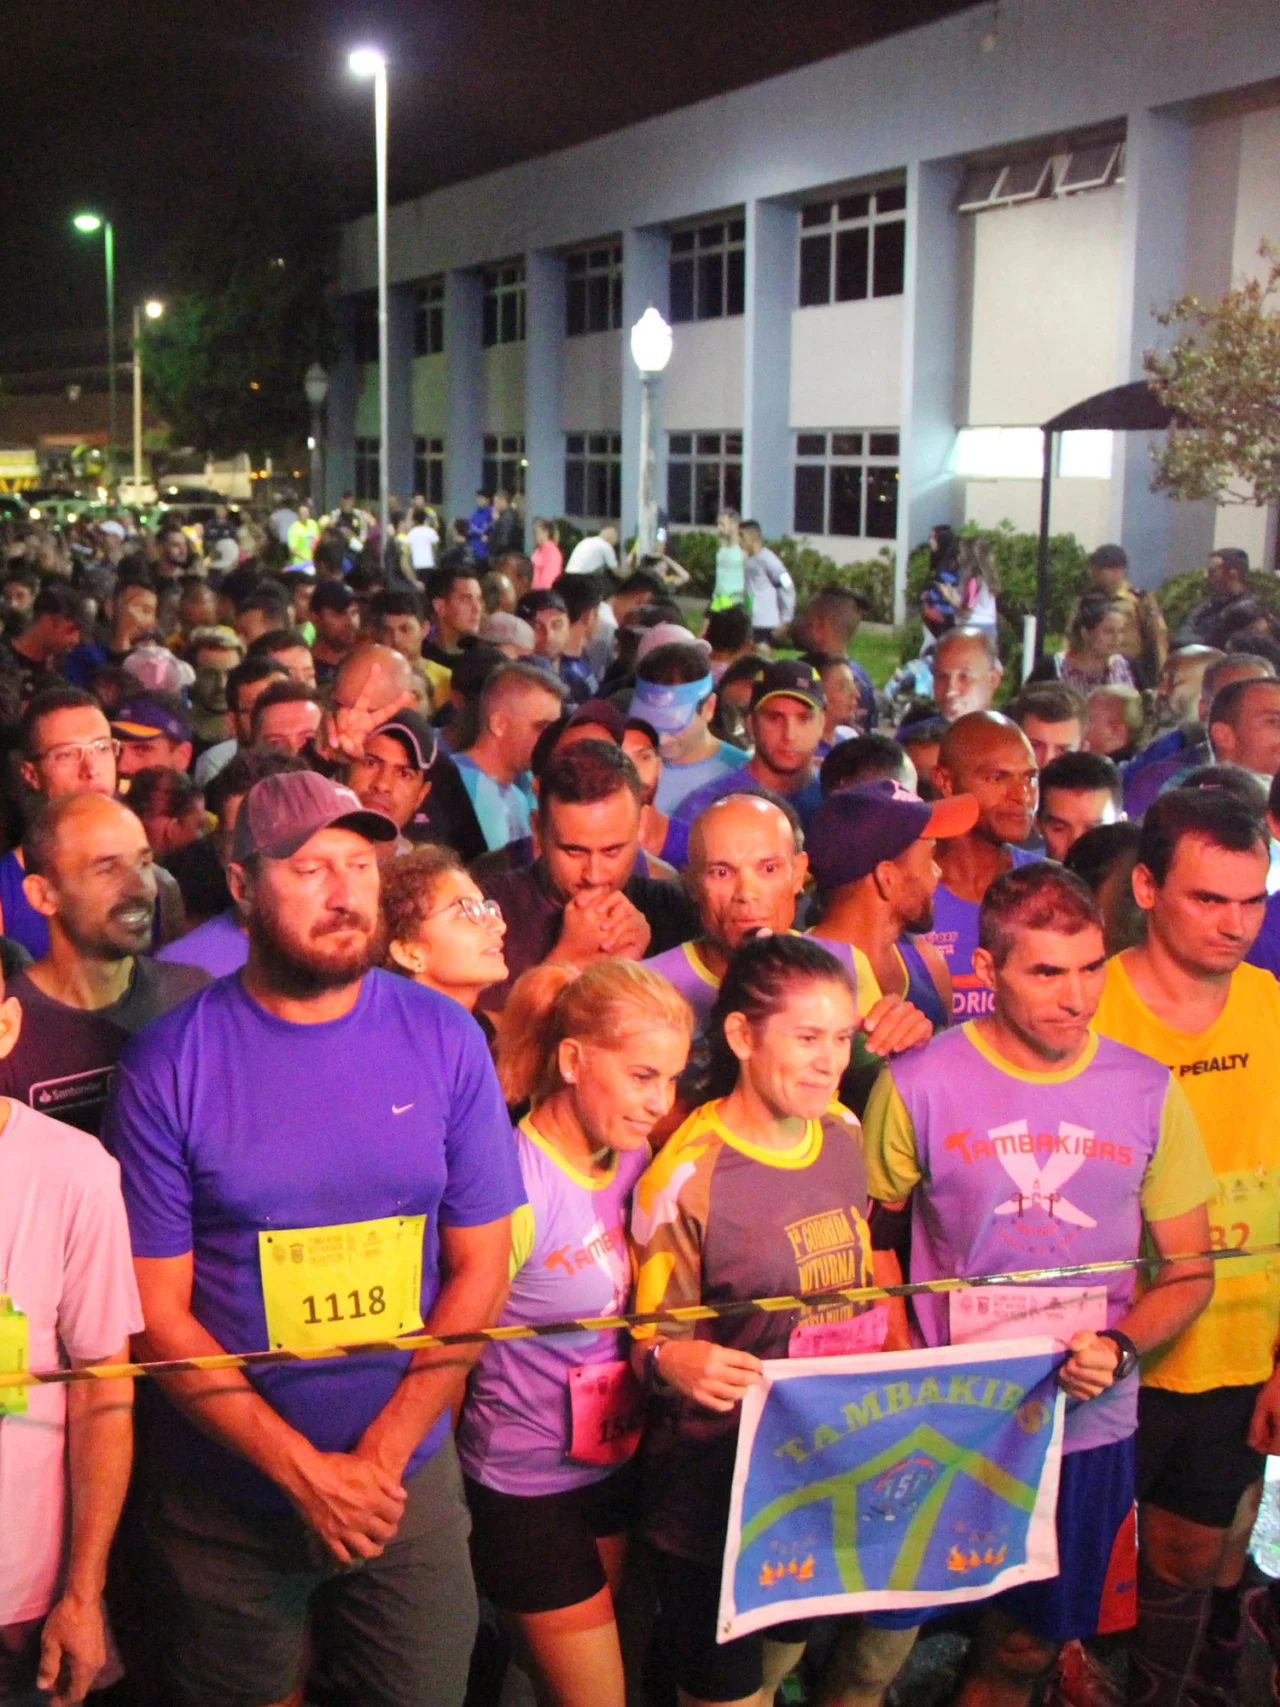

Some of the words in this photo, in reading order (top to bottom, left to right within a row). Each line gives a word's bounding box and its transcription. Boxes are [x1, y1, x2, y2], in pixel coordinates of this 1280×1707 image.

[945, 1129, 1134, 1166] TAMBAKIBAS
[801, 1213, 855, 1254] CORRIDA
[302, 1285, 386, 1324] 1118
